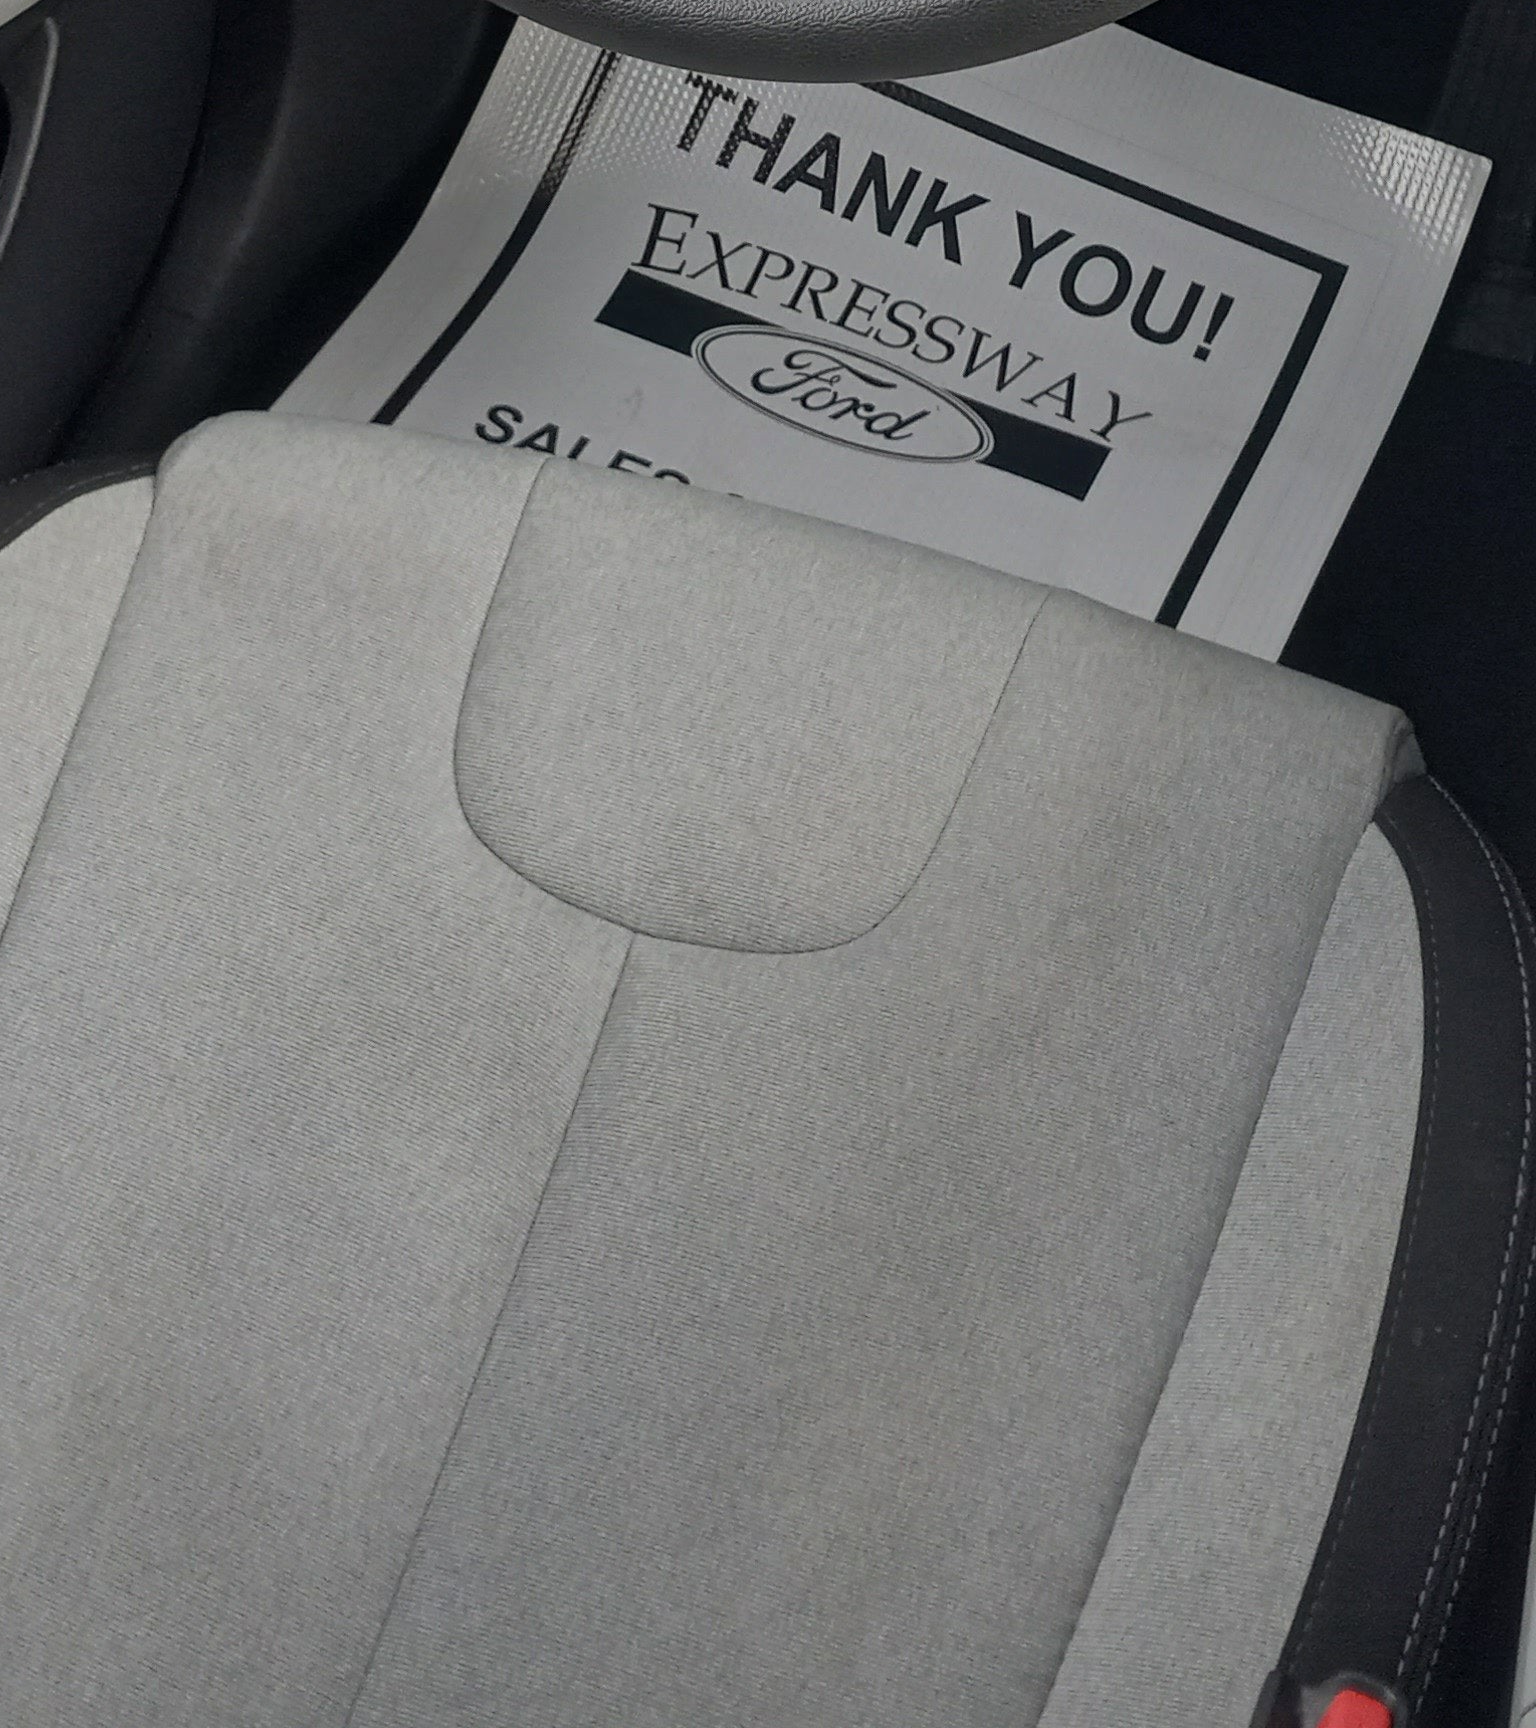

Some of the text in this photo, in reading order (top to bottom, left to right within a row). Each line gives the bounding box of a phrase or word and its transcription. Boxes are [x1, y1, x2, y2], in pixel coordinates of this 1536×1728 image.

[631, 202, 1155, 443] EXPRESSWAY
[672, 70, 1236, 364] THANK YOU!
[750, 349, 931, 445] Ford
